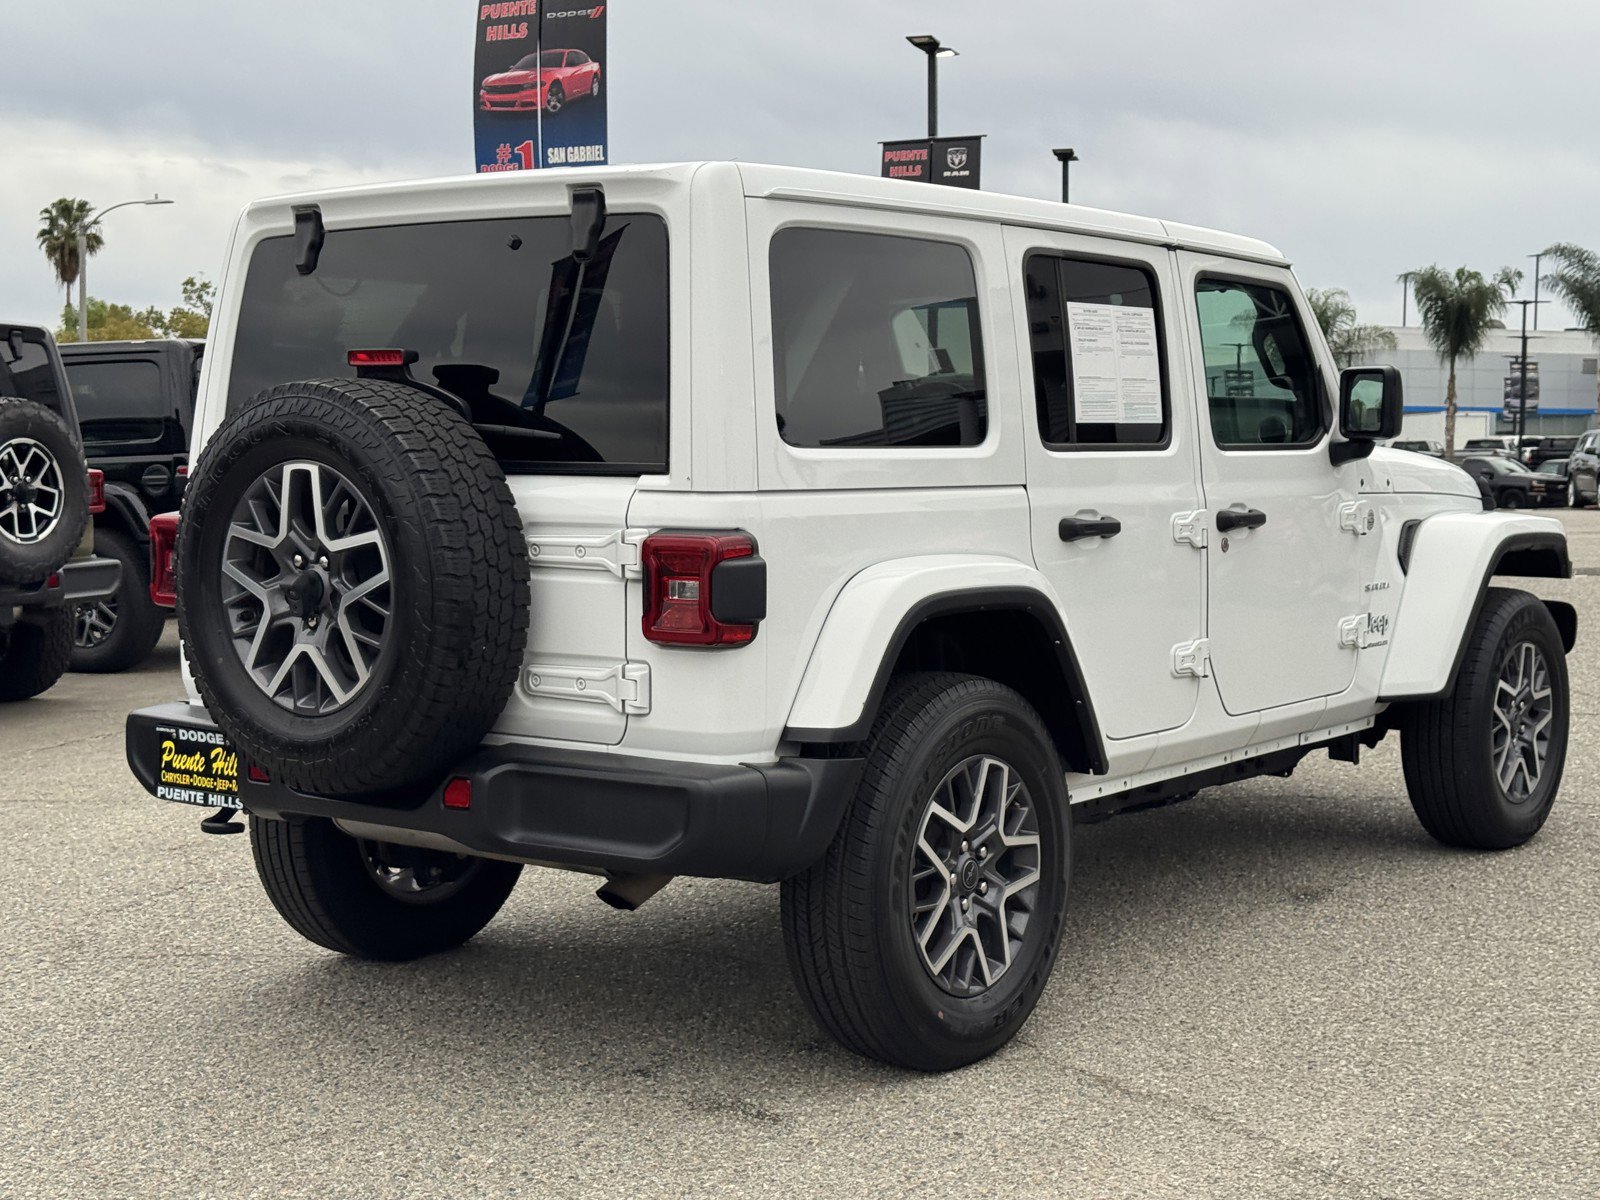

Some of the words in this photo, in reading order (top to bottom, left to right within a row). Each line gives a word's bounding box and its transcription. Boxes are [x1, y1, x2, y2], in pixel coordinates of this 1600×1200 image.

[480, 0, 537, 20] PUENTE
[546, 8, 597, 19] DODGE
[486, 22, 529, 42] HILLS
[547, 147, 566, 164] SAN
[567, 145, 605, 163] GABRIEL
[884, 148, 928, 162] PUENTE
[889, 164, 922, 177] HILLS
[1367, 612, 1389, 636] Jeep
[178, 728, 225, 745] DODGE
[161, 740, 206, 772] Puente
[210, 747, 238, 777] Hill
[161, 770, 191, 785] CHRYSLER
[193, 774, 214, 788] DODGE
[216, 777, 230, 791] JEEP
[157, 786, 205, 804] PUENTE
[208, 793, 244, 809] HILLS
